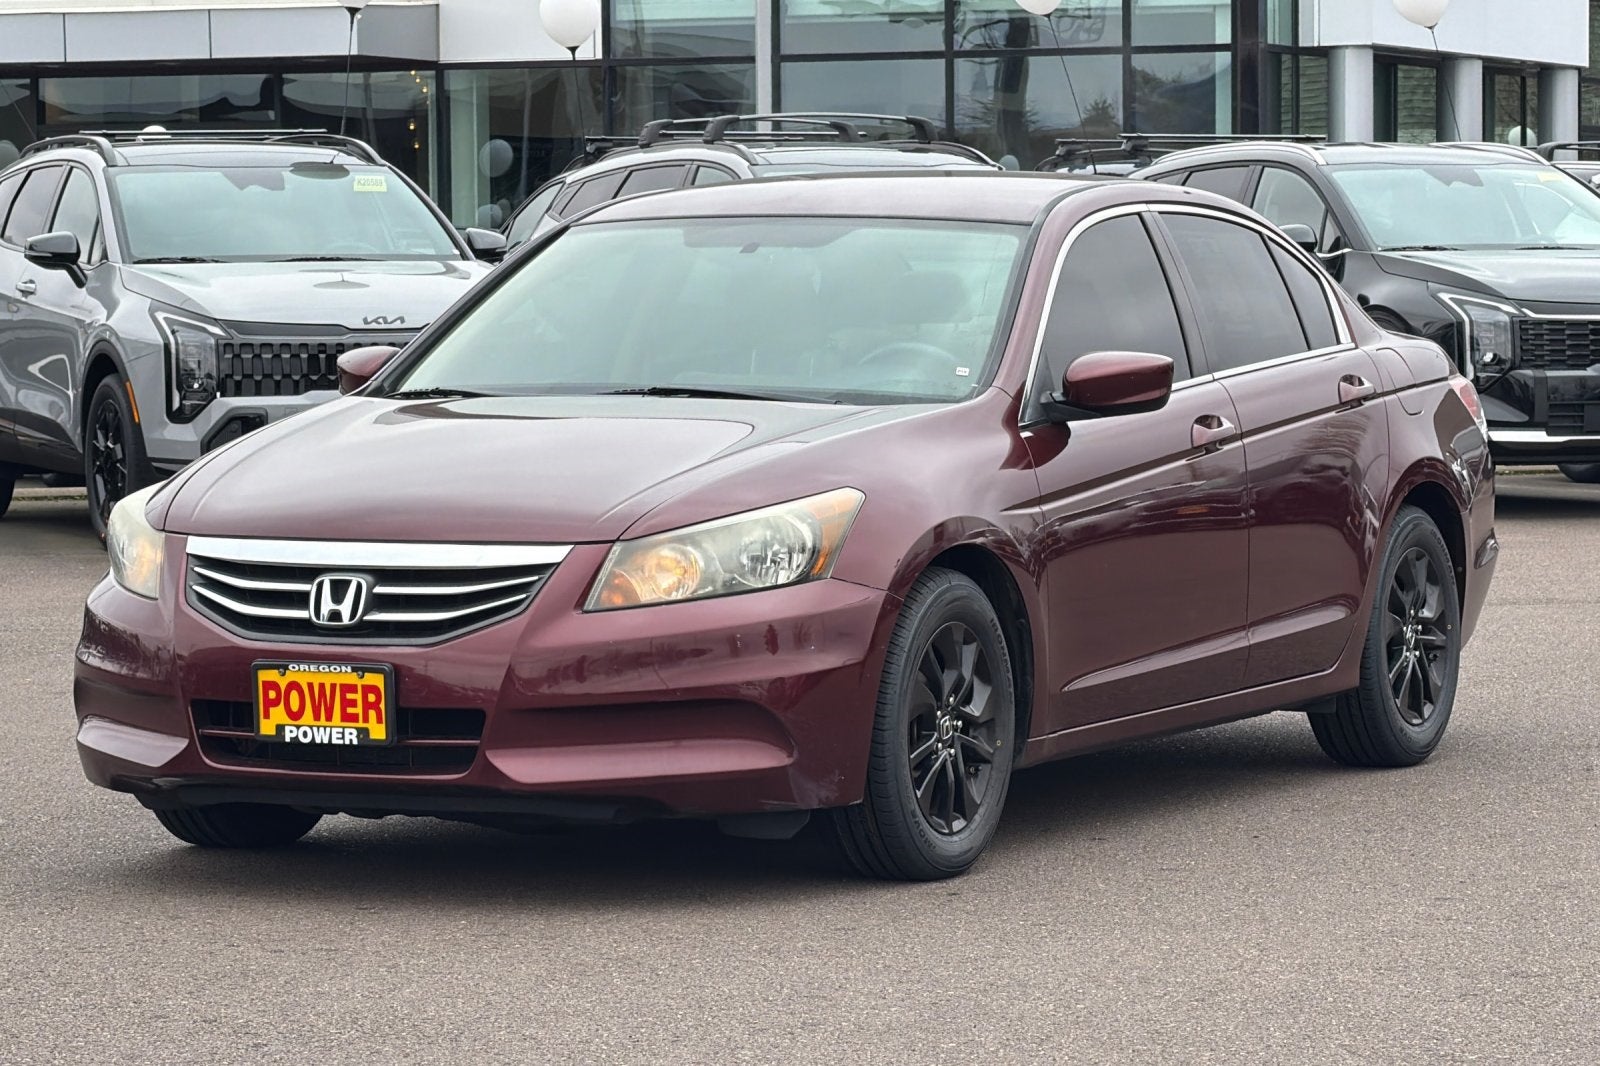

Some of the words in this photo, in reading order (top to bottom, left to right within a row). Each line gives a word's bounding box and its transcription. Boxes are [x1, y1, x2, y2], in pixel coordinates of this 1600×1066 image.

[288, 664, 352, 673] OREGON
[261, 680, 384, 724] POWER
[284, 725, 359, 745] POWER
